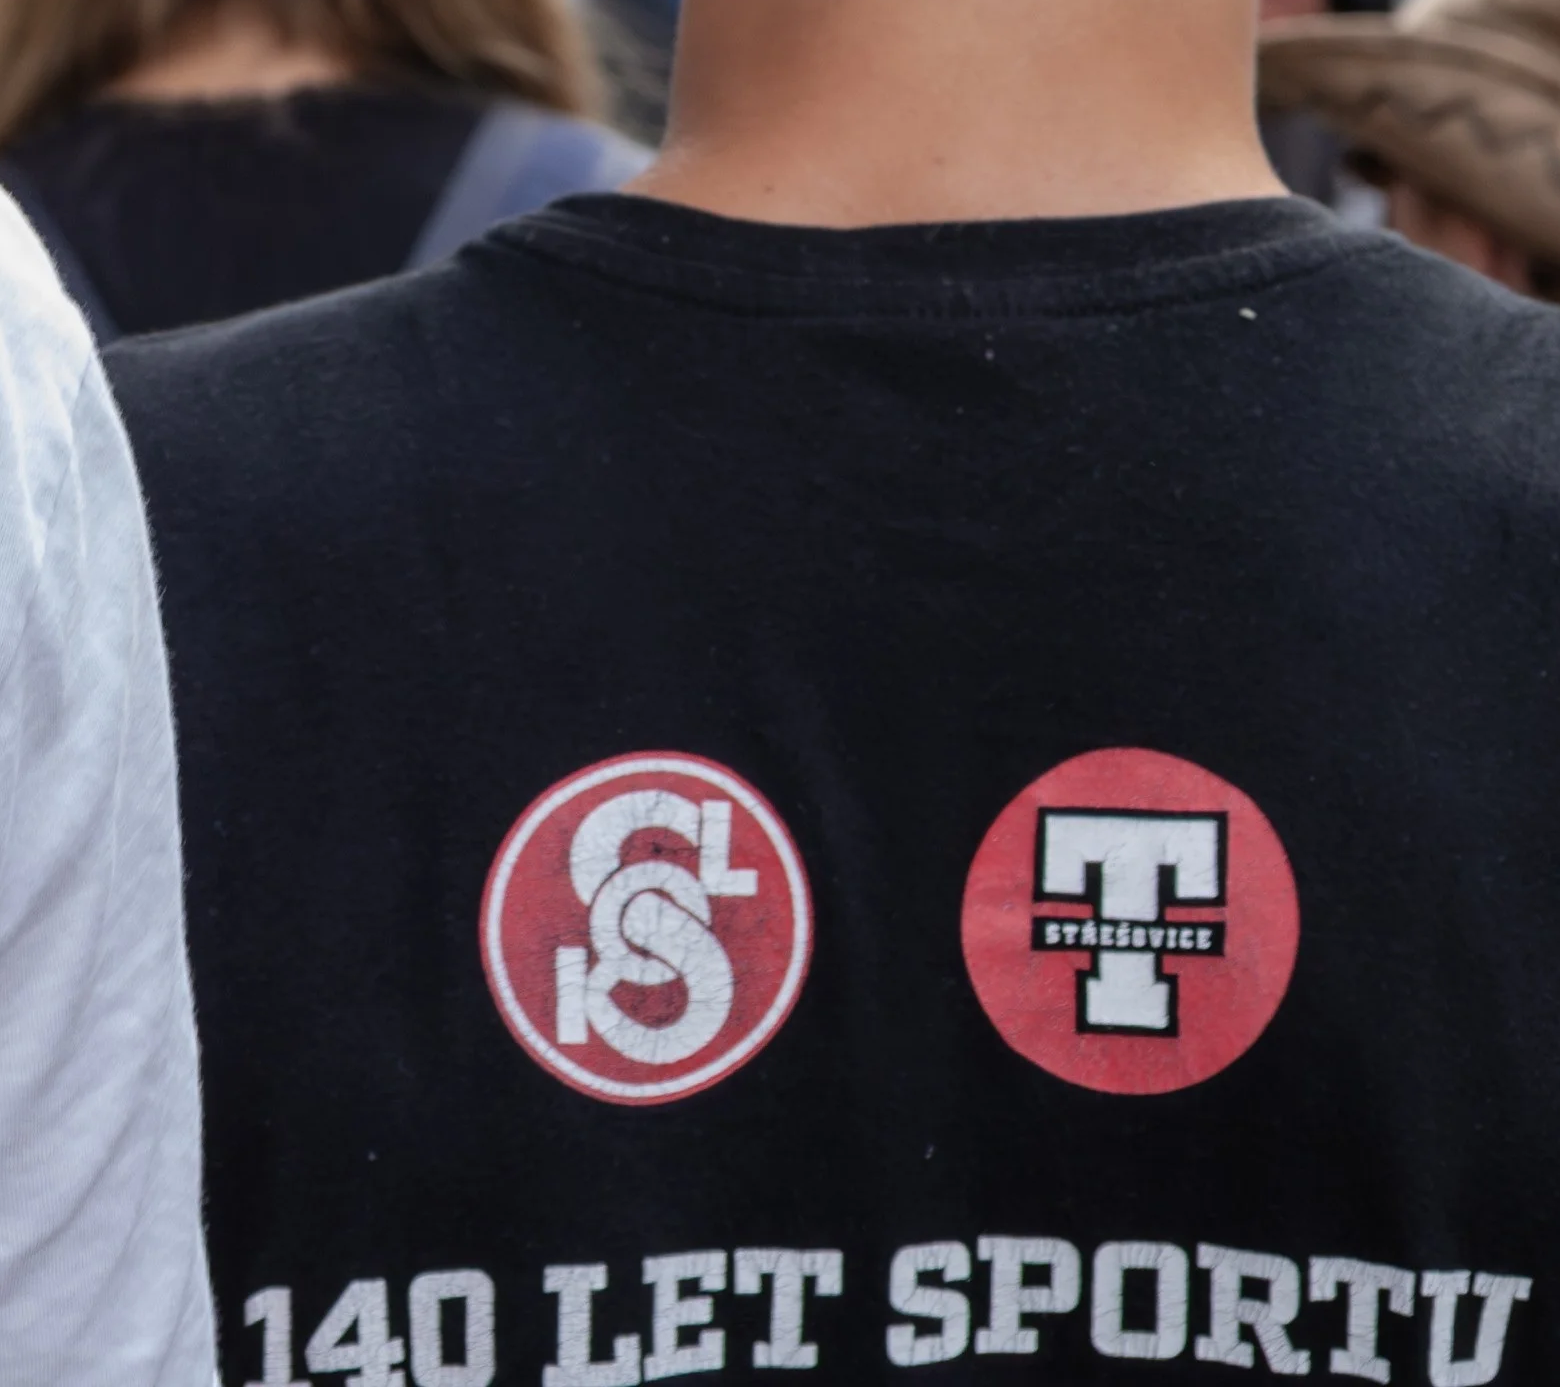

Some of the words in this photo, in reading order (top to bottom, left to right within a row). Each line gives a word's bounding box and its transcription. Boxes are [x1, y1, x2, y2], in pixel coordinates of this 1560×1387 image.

[244, 1269, 496, 1387] 140
[543, 1249, 843, 1387] LET
[886, 1235, 1533, 1387] SPORTU
